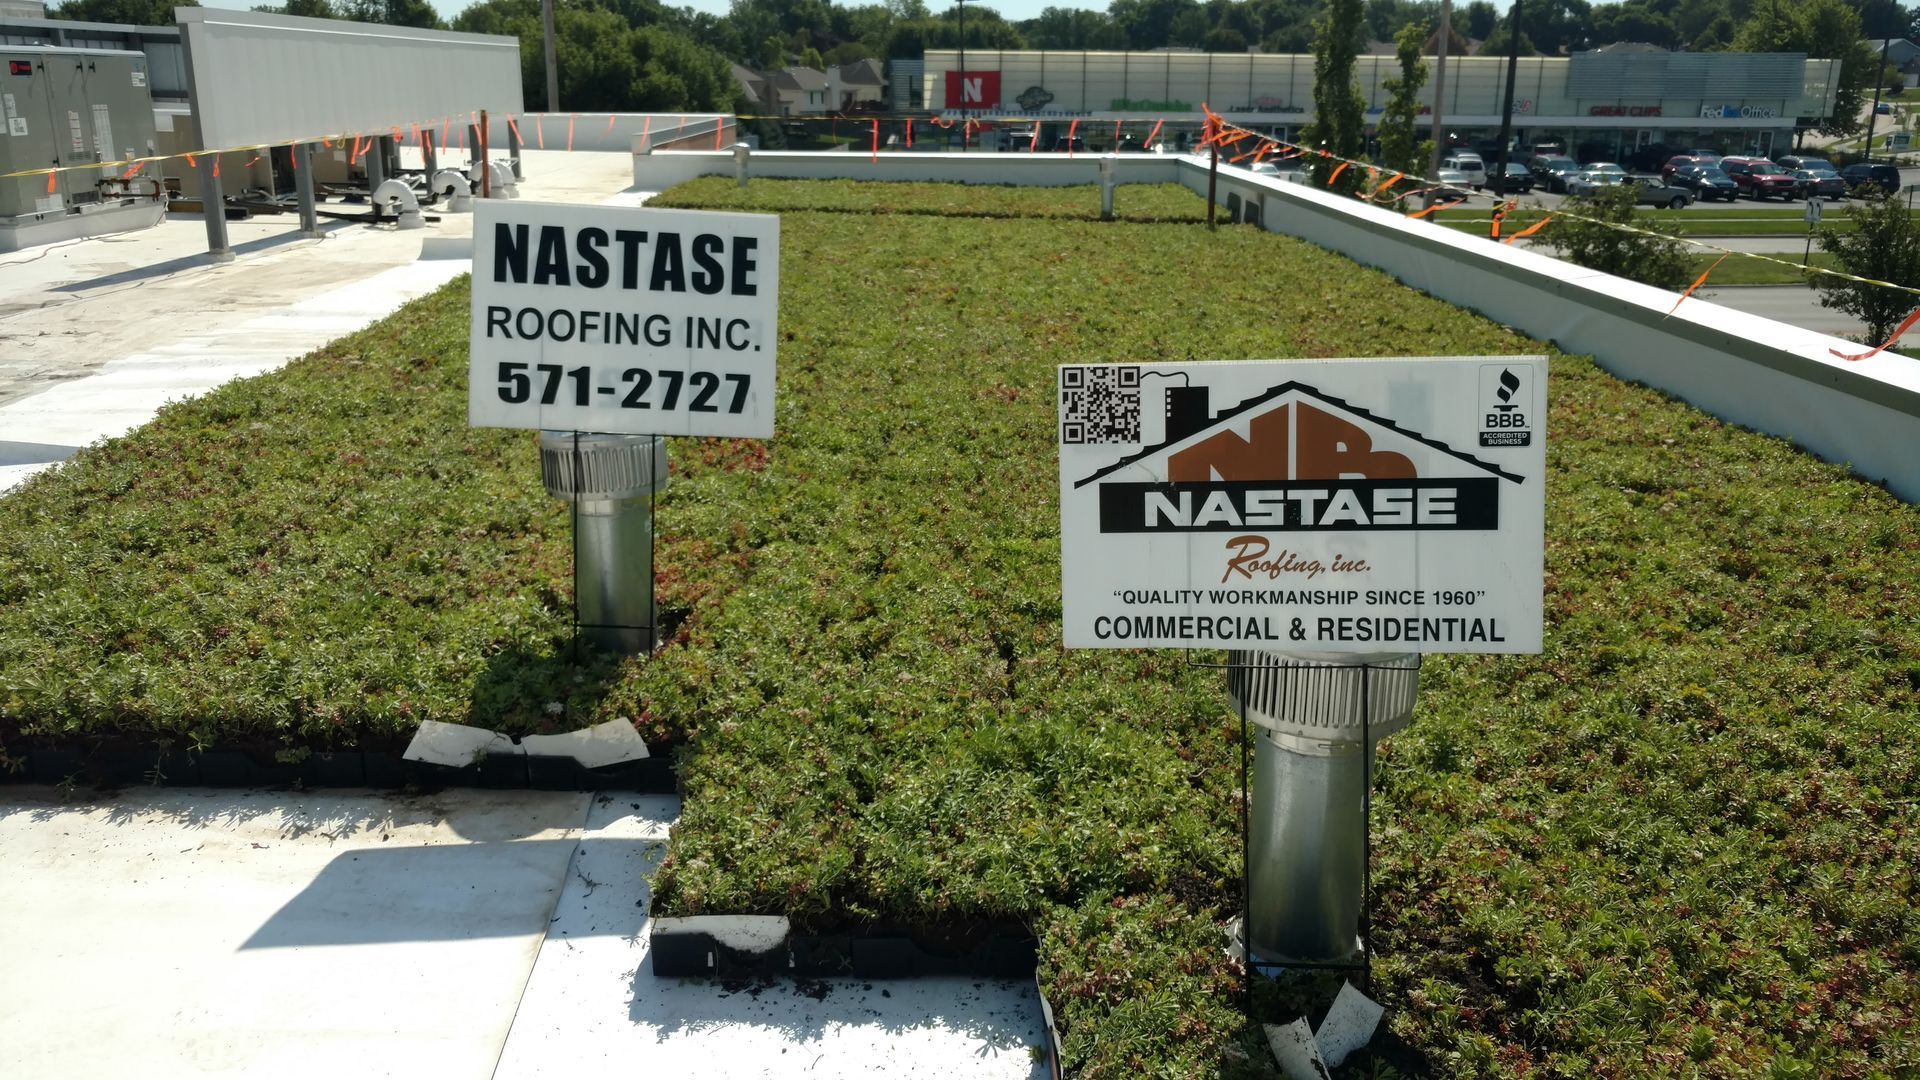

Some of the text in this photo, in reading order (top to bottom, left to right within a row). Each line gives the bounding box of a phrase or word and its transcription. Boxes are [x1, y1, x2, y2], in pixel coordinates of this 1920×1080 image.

[1740, 105, 1777, 119] Office
[493, 222, 758, 297] NASTASE
[486, 305, 761, 352] ROOFING INC.
[497, 361, 751, 414] 571-2727
[1486, 413, 1525, 428] BBB
[1144, 487, 1457, 528] NASTASE
[1331, 553, 1372, 573] inc.
[1208, 590, 1360, 605] WORKMANSHIP
[1365, 590, 1426, 606] SINCE
[1094, 615, 1506, 643] COMMERCIAL & RESIDENTIAL
